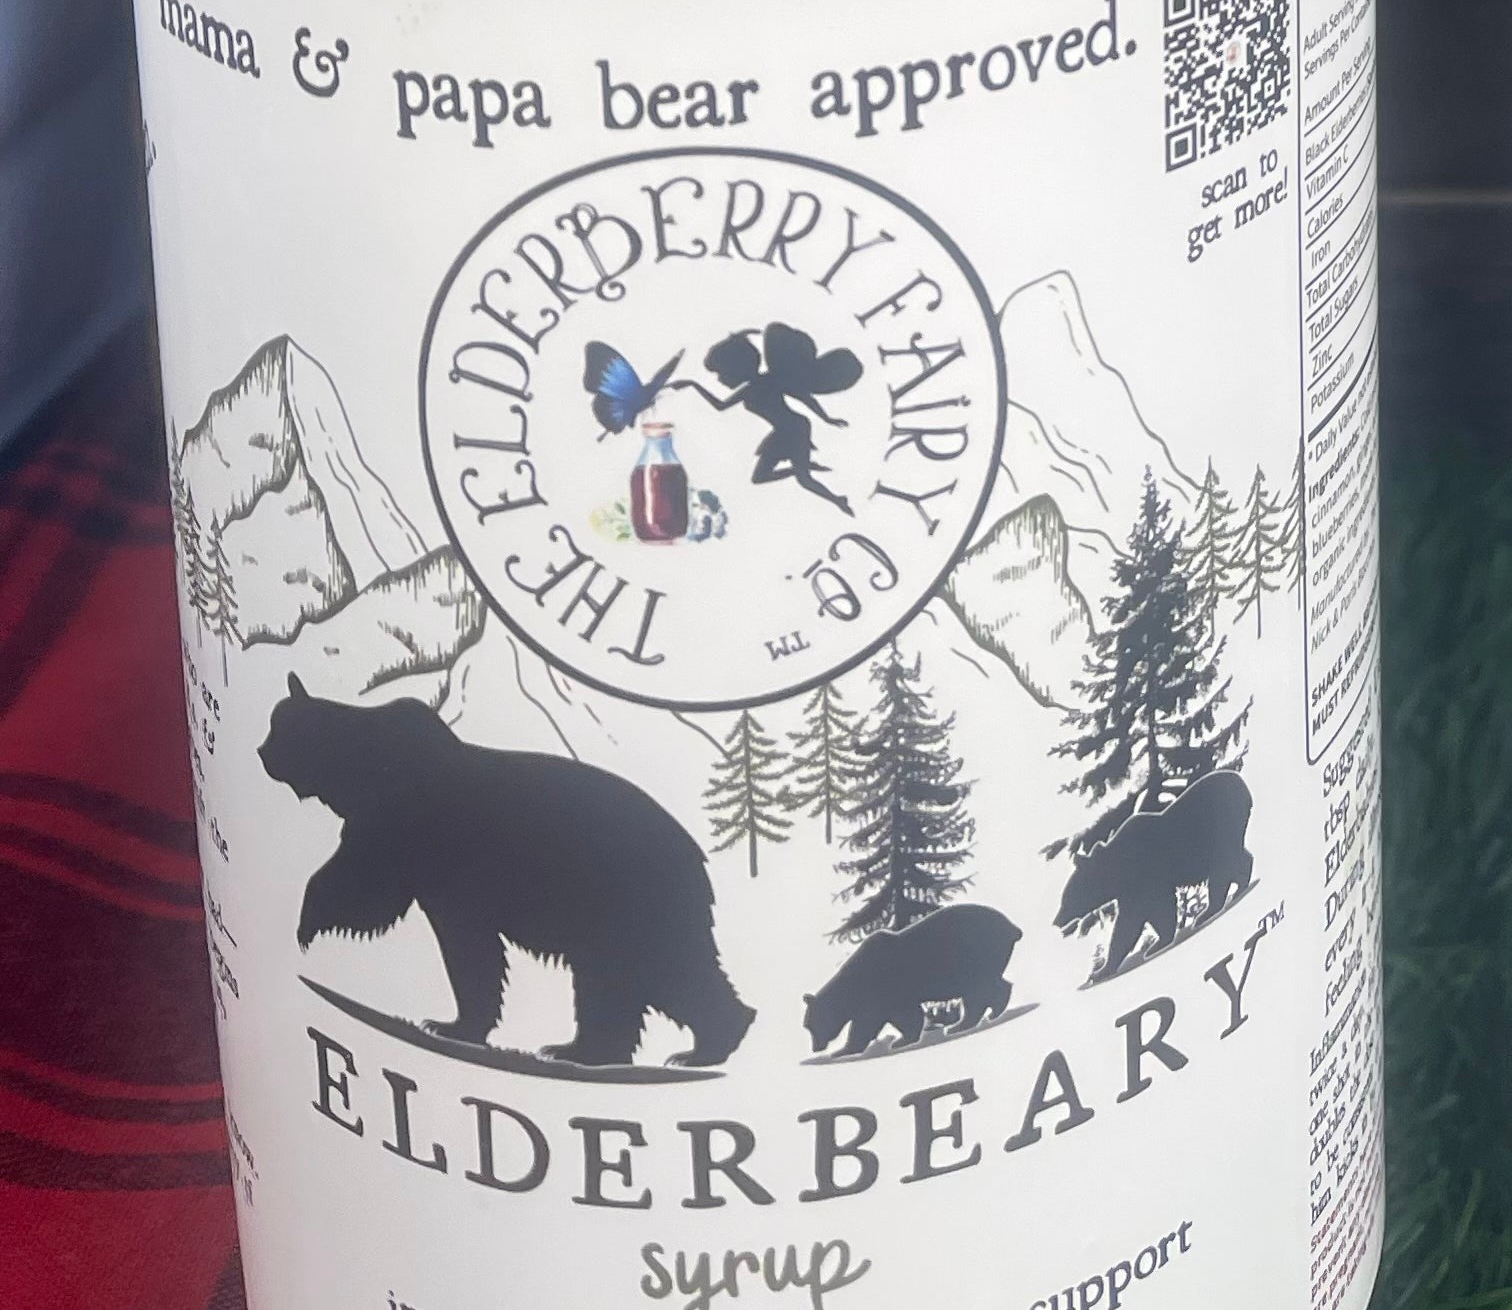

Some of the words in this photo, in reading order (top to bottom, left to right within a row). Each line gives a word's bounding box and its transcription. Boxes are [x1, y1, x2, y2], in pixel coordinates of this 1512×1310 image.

[1303, 21, 1328, 54] Adult
[1304, 38, 1339, 81] Servings
[292, 27, 350, 98] &
[391, 69, 552, 149] papa
[595, 59, 760, 131] bear
[1304, 80, 1341, 127] Amount
[1200, 163, 1248, 208] scan
[1258, 147, 1279, 181] to
[1305, 131, 1331, 167] Black
[1306, 155, 1343, 200] Vitamin
[1343, 143, 1349, 165] C
[1186, 211, 1223, 264] get
[1233, 166, 1289, 231] more!
[1307, 193, 1344, 240] Calories
[1311, 239, 1331, 270] Iron
[1306, 271, 1331, 310] Total
[1308, 305, 1333, 343] Total
[1334, 274, 1359, 319] Sugars
[448, 175, 895, 526] ELDERBERRY
[1311, 342, 1333, 379] Zinc
[854, 269, 970, 537] FAIRY
[1310, 351, 1355, 414] Potassium
[1315, 425, 1338, 463] Daily
[1338, 398, 1357, 434] Value
[504, 522, 667, 668] THE
[1311, 653, 1343, 708] SHAKE
[1311, 688, 1340, 736] MUST
[306, 939, 1258, 1210] ELDERBEARY
[640, 1238, 873, 1310] syrup
[1029, 1220, 1193, 1310] upport
